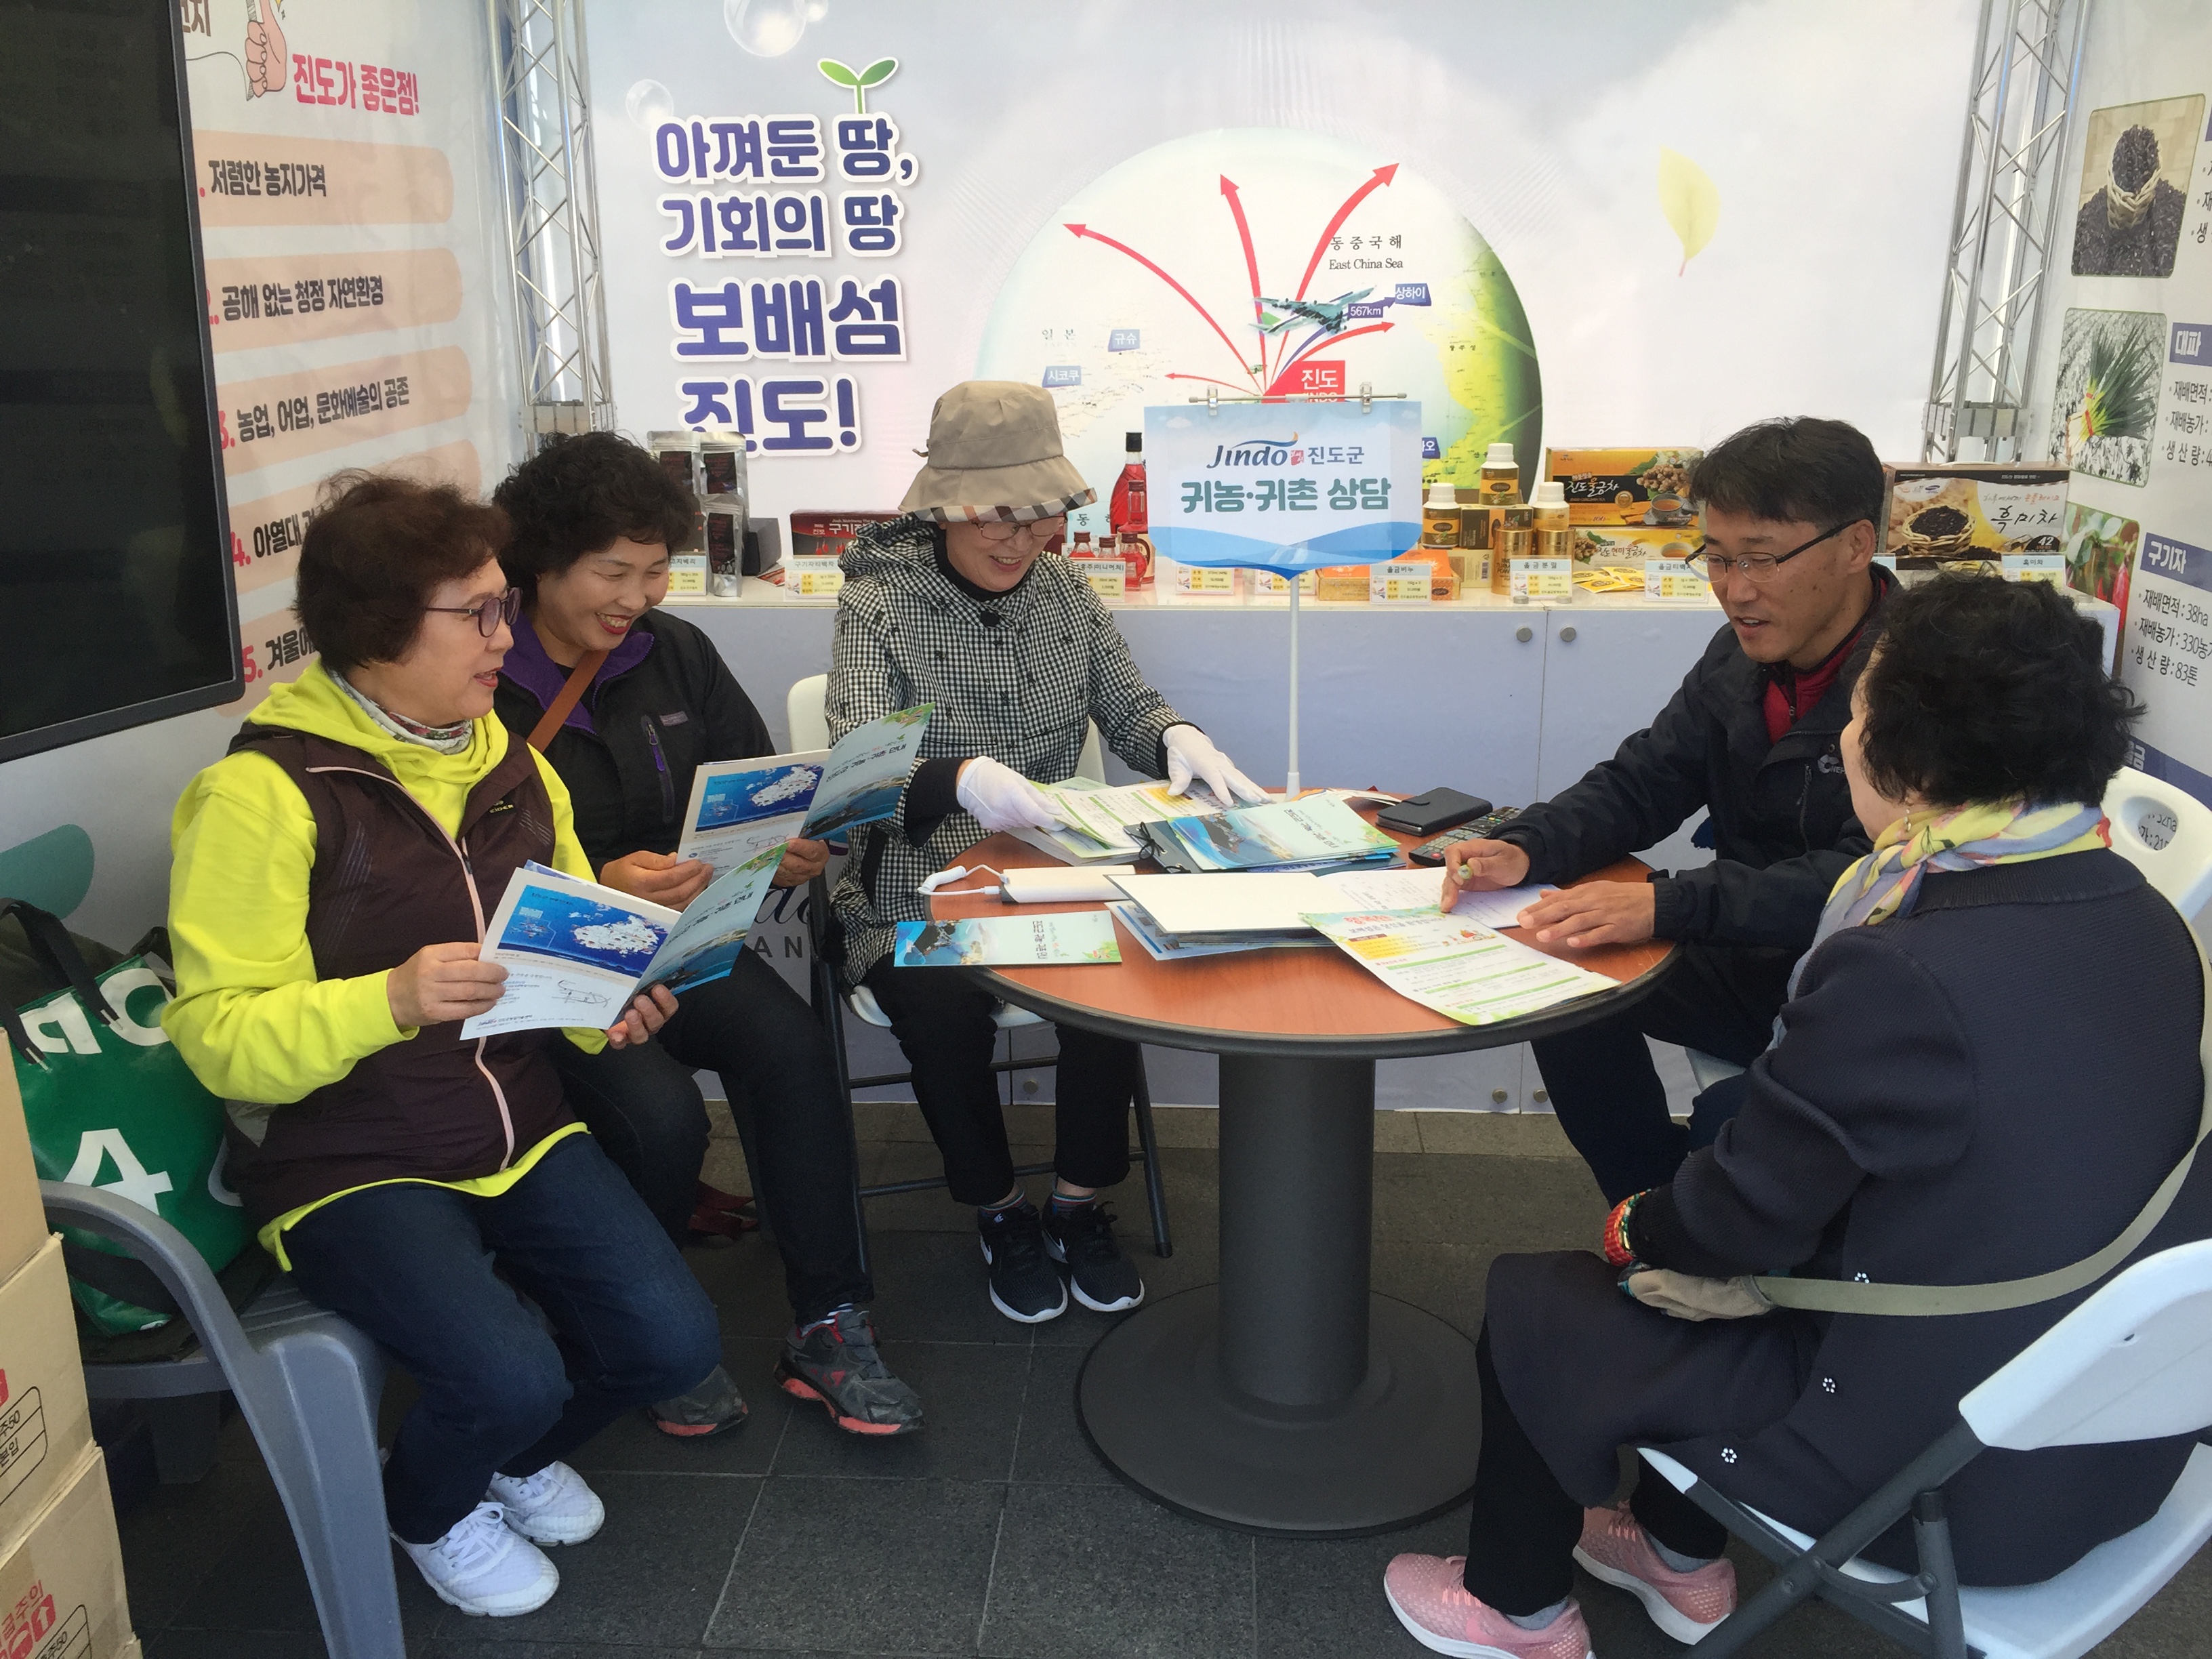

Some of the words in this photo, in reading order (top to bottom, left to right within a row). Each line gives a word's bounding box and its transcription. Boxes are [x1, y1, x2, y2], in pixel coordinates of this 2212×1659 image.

[292, 54, 356, 108] 진도가
[361, 64, 419, 116] 좋은점!
[656, 120, 819, 179] 아껴둔
[838, 117, 913, 180] 땅,
[208, 161, 261, 196] 저렴한
[264, 163, 327, 197] 농지가격
[661, 194, 826, 253] 기회의
[844, 194, 899, 251] 땅
[1329, 258, 1351, 270] East
[1353, 258, 1382, 269] China
[1385, 258, 1404, 269] Sea
[222, 285, 259, 322] 공해
[264, 283, 293, 316] 없는
[294, 279, 325, 312] 청정
[329, 274, 384, 310] 자연환경
[1350, 306, 1381, 316] 567km
[1395, 287, 1426, 300] 상하이
[674, 278, 902, 356] 보배섬
[1114, 333, 1136, 345] 규슈
[2175, 329, 2202, 357] 대파
[1048, 369, 1080, 382] 시코쿠
[1301, 369, 1338, 390] 진도
[237, 405, 275, 443] 농업,
[276, 396, 314, 432] 어업,
[316, 381, 384, 424] 문화예술의
[384, 376, 409, 408] 공존
[680, 377, 857, 451] 진도!
[1206, 444, 1289, 469] Jindo
[1307, 446, 1365, 465] 진도군
[1181, 478, 1317, 513] 귀농·귀촌
[1327, 477, 1391, 511] 상담
[253, 514, 303, 558] 아열대
[1990, 505, 2057, 533] 흑미차
[2038, 529, 2055, 546] 42
[2148, 540, 2188, 575] 구기자
[243, 645, 263, 684] 5.
